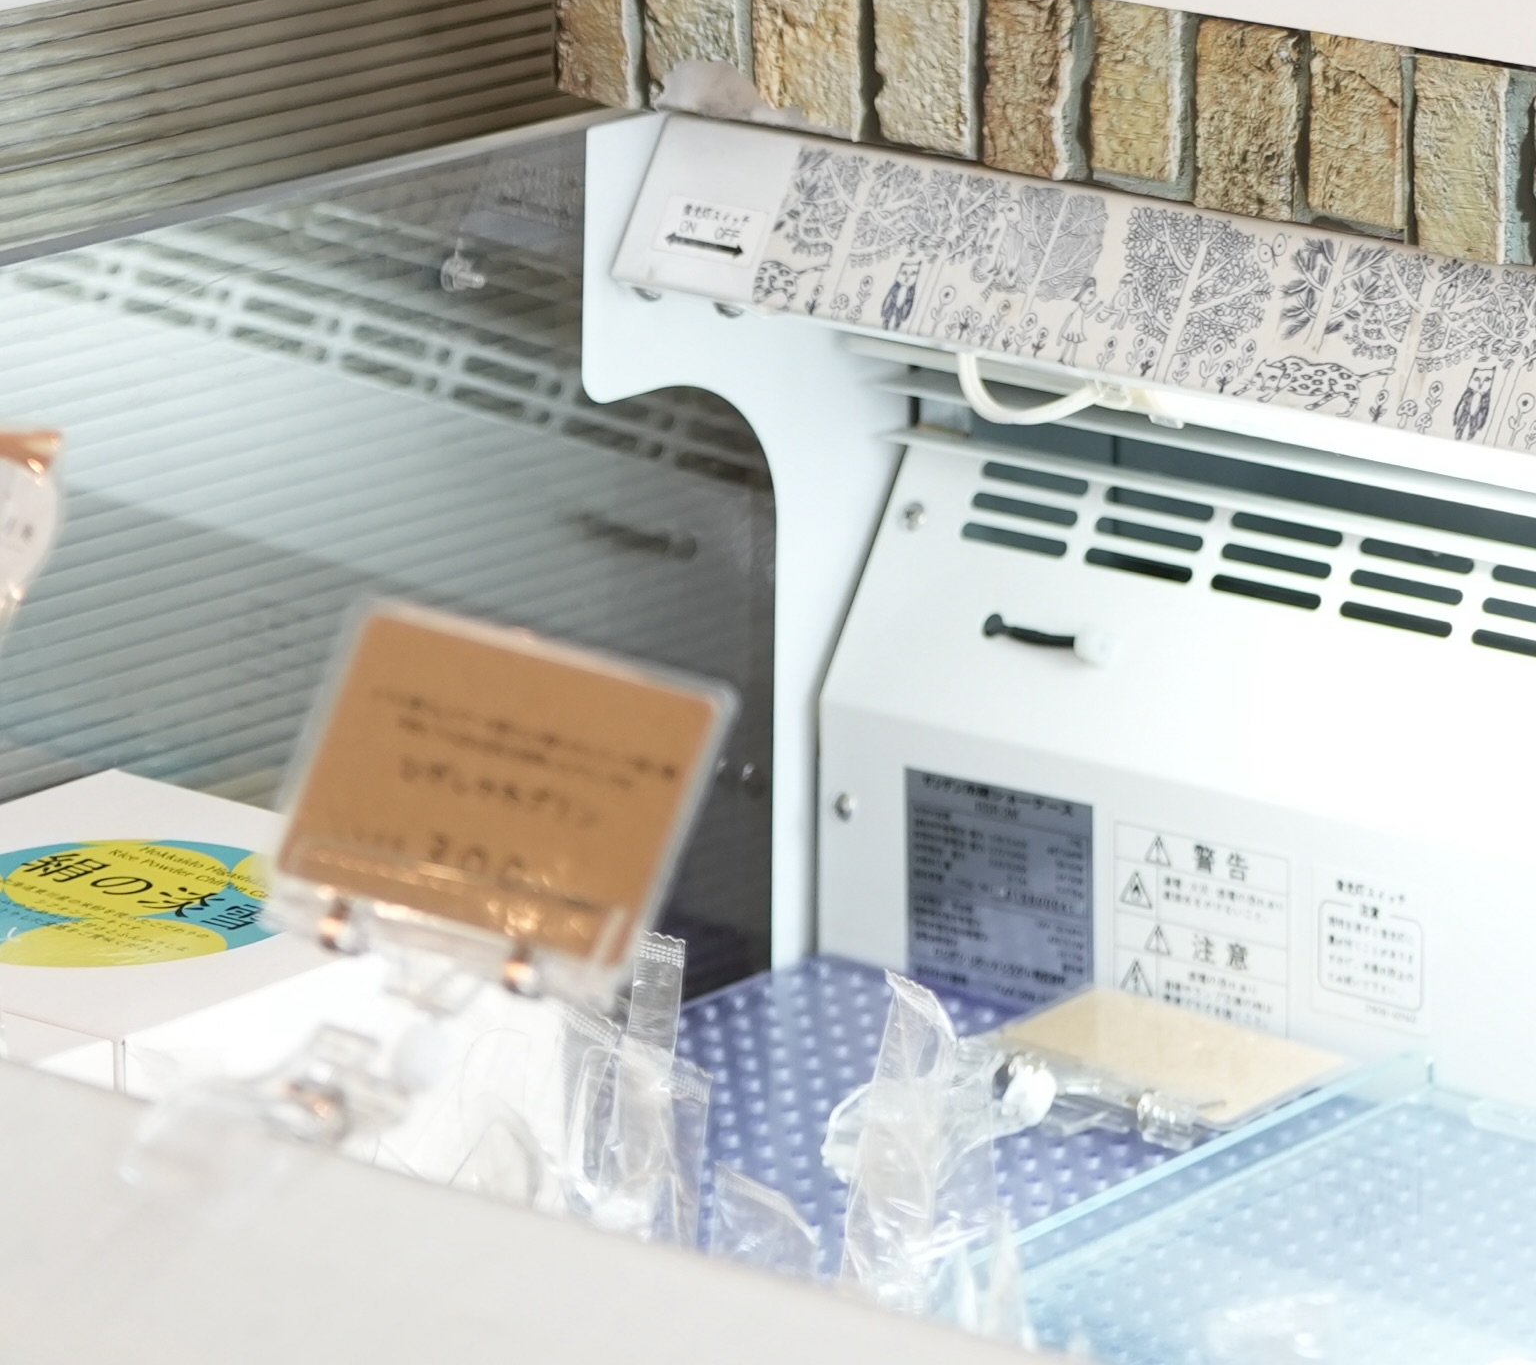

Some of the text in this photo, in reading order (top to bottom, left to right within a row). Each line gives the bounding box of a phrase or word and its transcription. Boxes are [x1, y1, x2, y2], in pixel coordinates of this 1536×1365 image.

[680, 220, 741, 242] ON OFF
[108, 848, 140, 862] Rice
[140, 857, 195, 878] Powder
[139, 845, 204, 869] Hokkaido
[1193, 843, 1250, 883] 警告
[21, 853, 267, 930] 絹の淡雪
[1192, 933, 1249, 971] 注意
